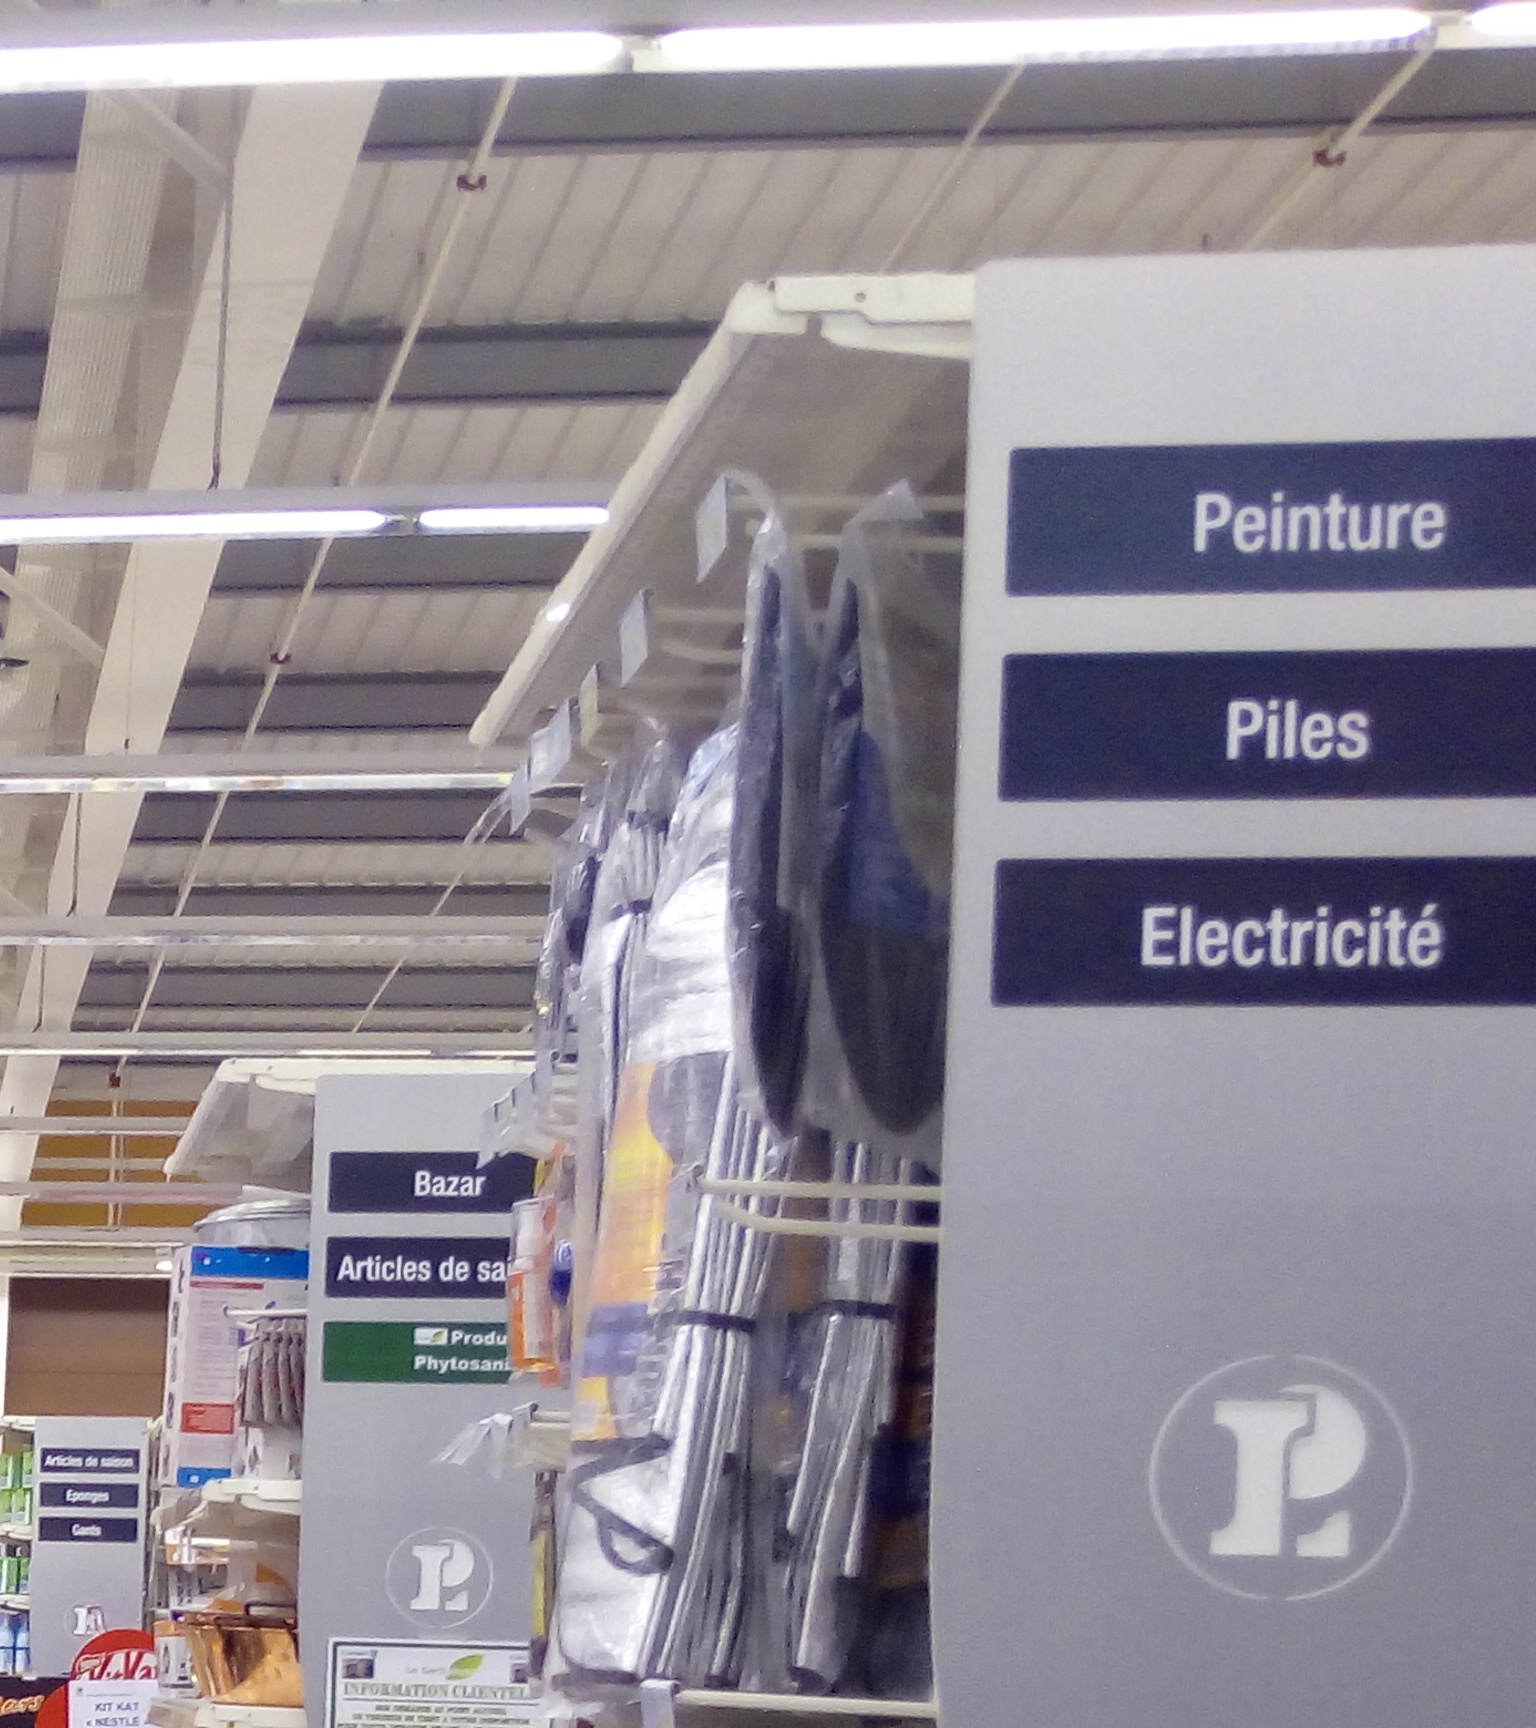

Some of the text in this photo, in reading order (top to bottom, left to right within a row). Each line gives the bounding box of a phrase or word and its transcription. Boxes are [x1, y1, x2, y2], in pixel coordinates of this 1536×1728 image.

[1192, 493, 1446, 554] Peinture
[1226, 701, 1371, 761] Piles
[1141, 900, 1443, 970] Electricité
[414, 1170, 486, 1197] Bazar
[336, 1255, 431, 1282] Articles
[438, 1255, 469, 1282] de
[451, 1331, 508, 1346] Produ
[414, 1355, 510, 1374] Phytosani
[45, 1455, 82, 1468] Articles
[85, 1456, 98, 1467] de
[344, 1683, 449, 1699] INFORMATION
